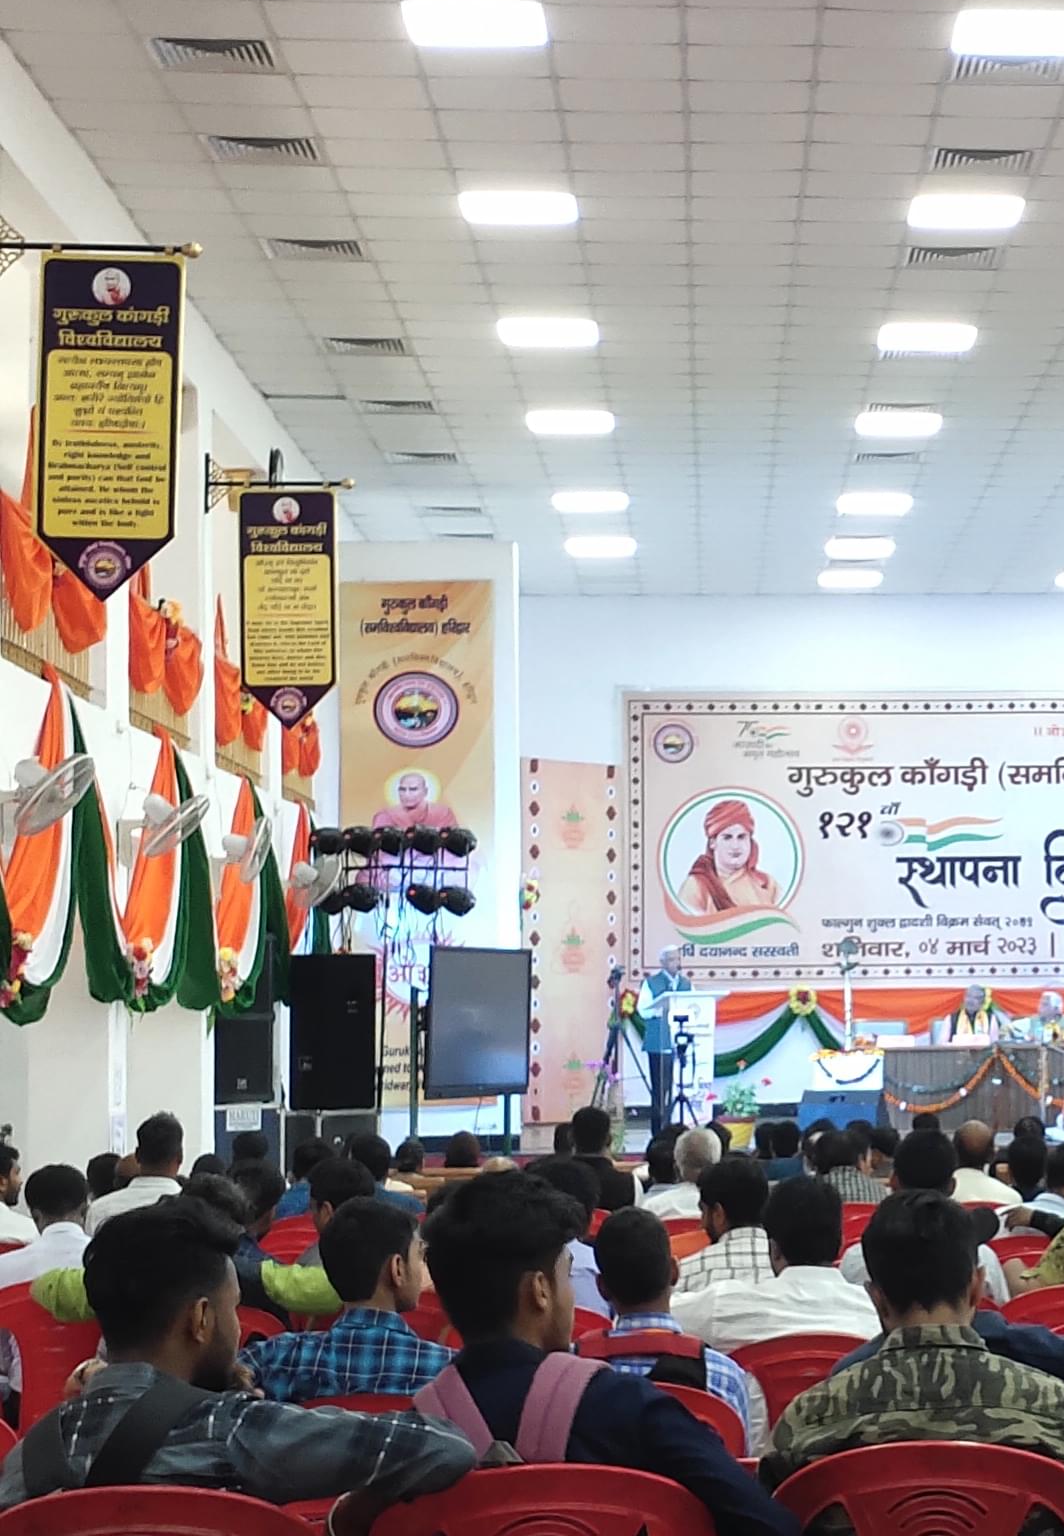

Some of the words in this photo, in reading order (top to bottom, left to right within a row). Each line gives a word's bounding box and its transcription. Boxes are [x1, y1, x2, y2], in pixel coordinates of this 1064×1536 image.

[52, 308, 113, 326] गुरुकुल
[59, 328, 163, 348] विश्वविद्यालय
[381, 597, 416, 615] गुरुकुल
[787, 766, 895, 797] गुरुकुल
[900, 757, 988, 792] काँगड़ी
[819, 810, 872, 840] १२१
[895, 855, 1022, 909] स्थापना
[936, 914, 969, 928] विक्रम
[700, 946, 747, 957] दयानन्द
[752, 942, 799, 957] सरस्वती
[919, 938, 939, 955] ०४
[946, 934, 991, 956] मार्च
[998, 937, 1037, 956] २०२३
